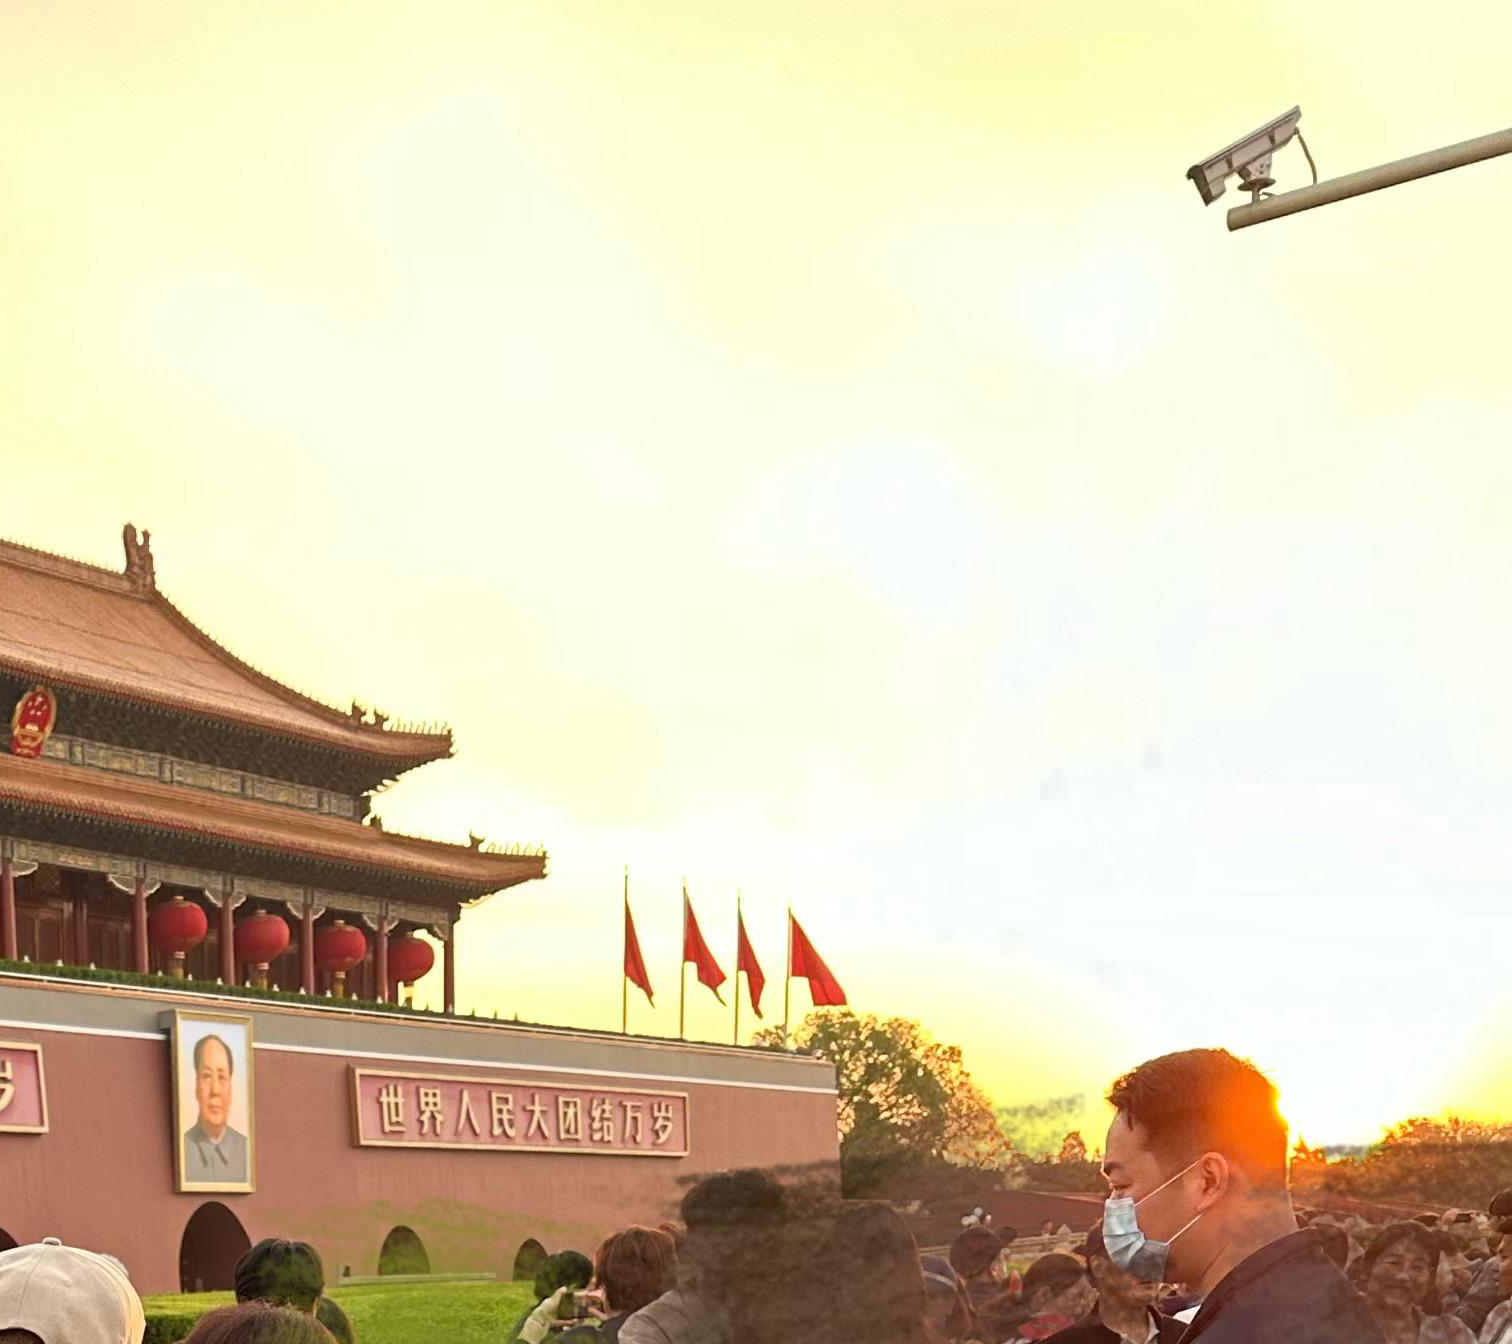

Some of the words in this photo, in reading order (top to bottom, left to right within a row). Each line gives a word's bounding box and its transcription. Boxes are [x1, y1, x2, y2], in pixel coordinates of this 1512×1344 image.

[378, 1084, 674, 1144] 世界人民大团结万岁
